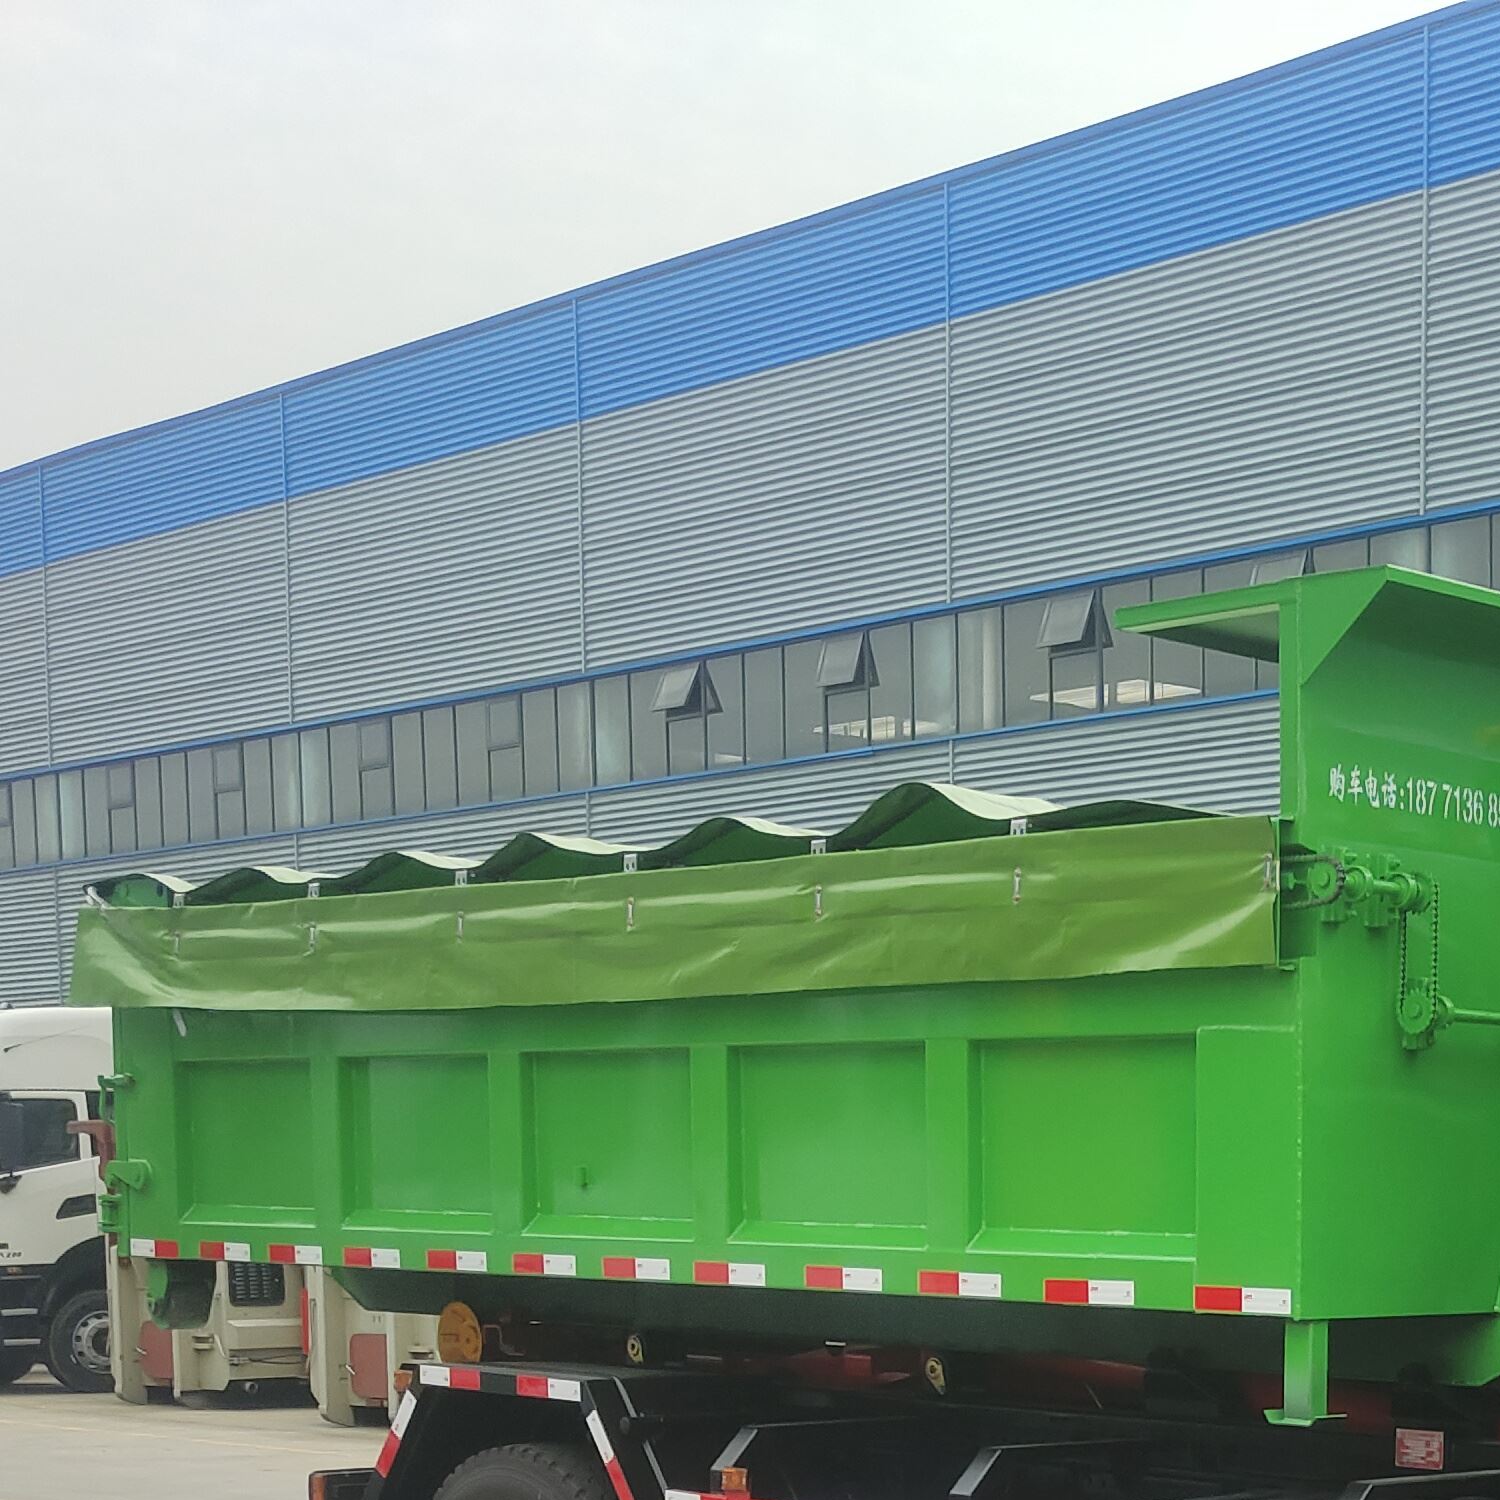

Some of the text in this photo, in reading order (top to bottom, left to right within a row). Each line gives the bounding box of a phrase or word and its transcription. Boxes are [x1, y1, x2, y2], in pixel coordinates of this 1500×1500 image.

[1328, 763, 1438, 817] 购车电话:187
[1442, 783, 1484, 826] 7136
